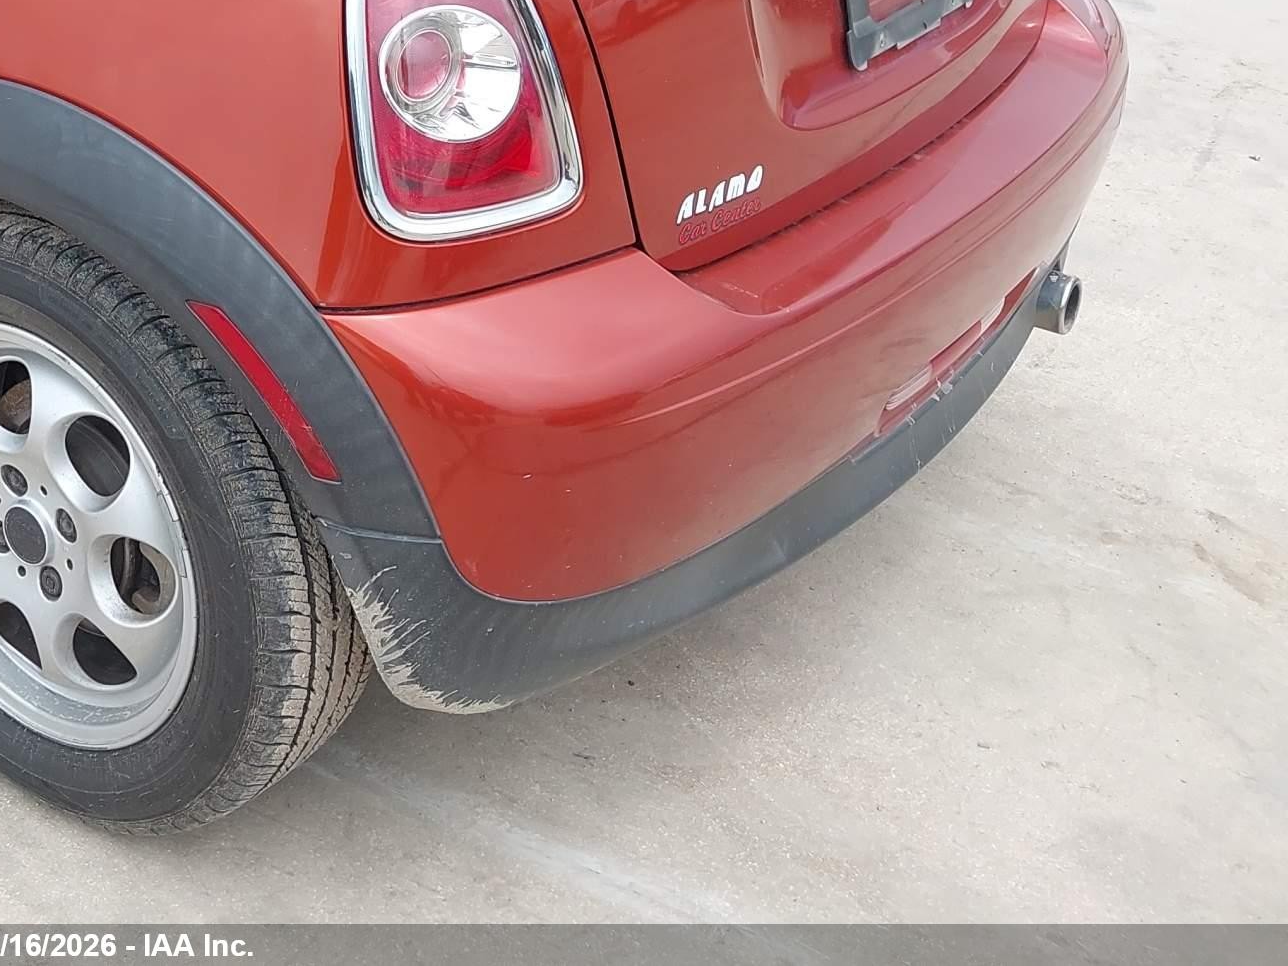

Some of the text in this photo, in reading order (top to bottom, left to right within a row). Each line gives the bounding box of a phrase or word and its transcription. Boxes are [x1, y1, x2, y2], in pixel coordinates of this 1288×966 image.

[676, 164, 764, 226] ALAMO
[679, 197, 761, 244] Car Center
